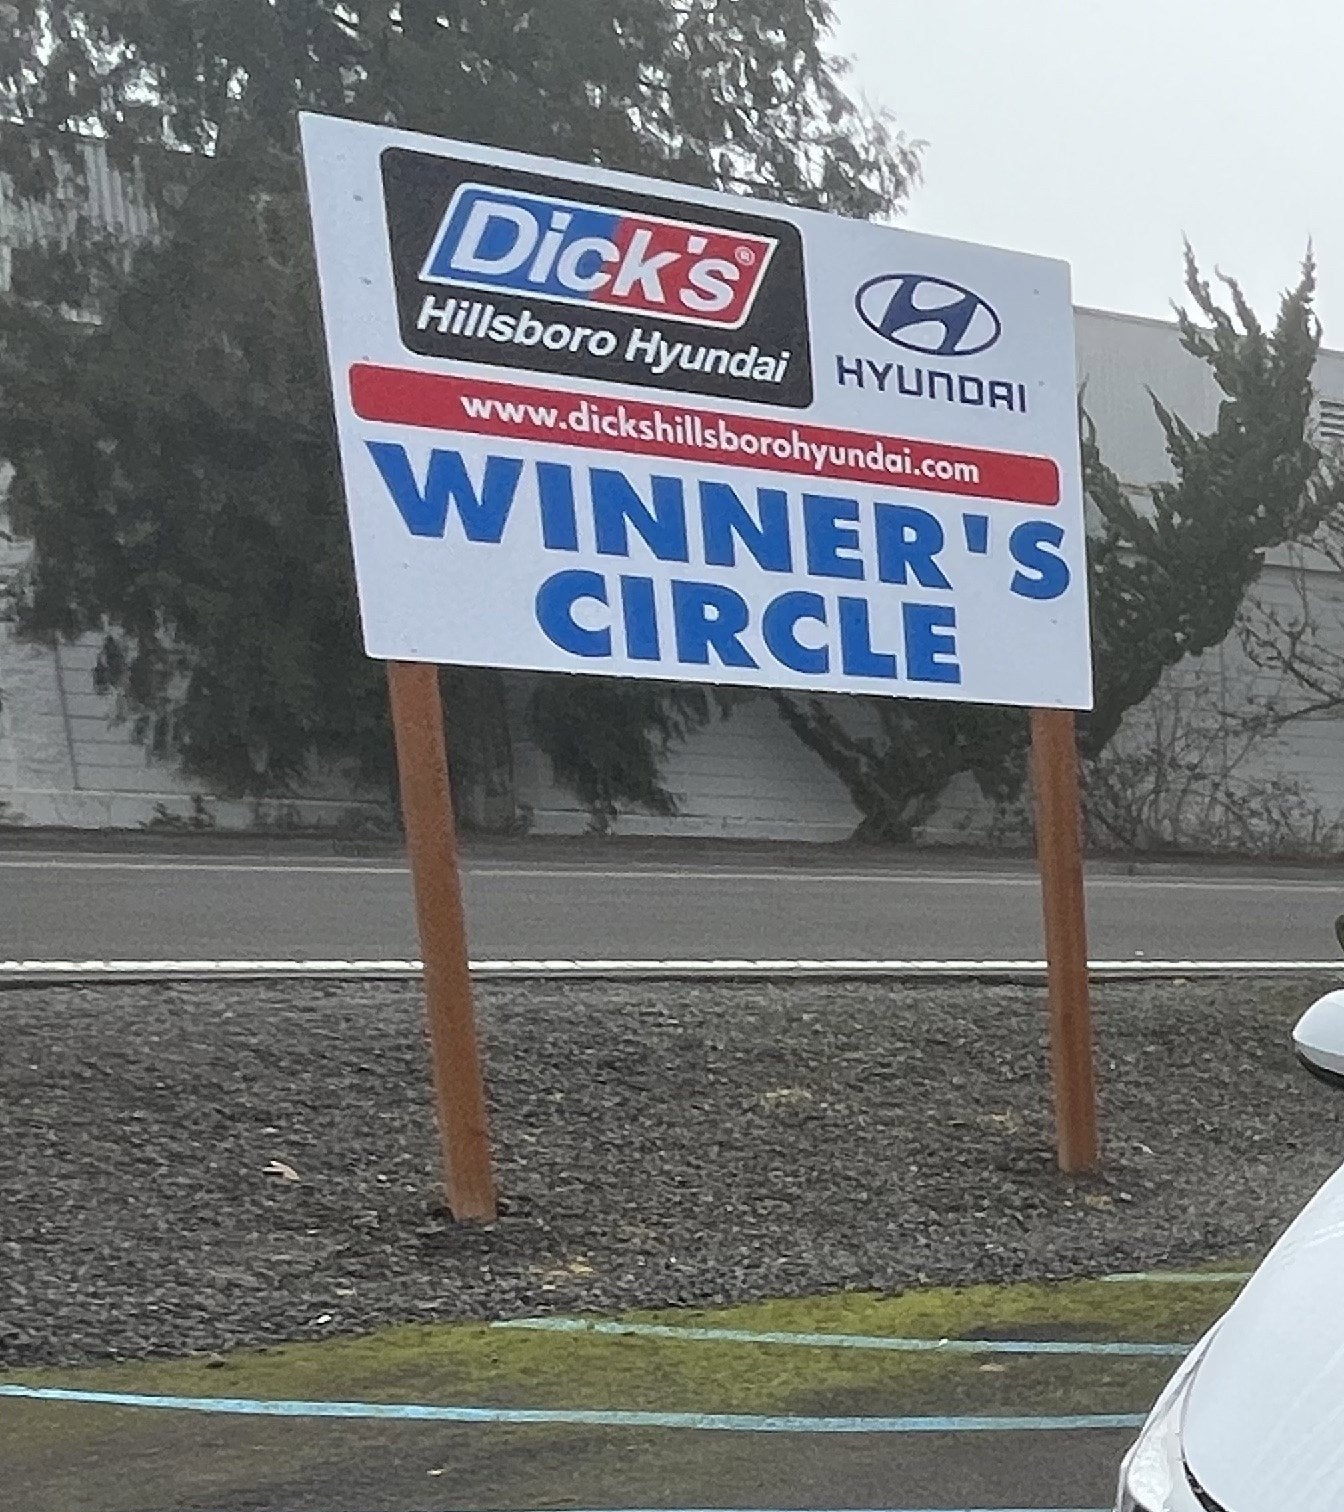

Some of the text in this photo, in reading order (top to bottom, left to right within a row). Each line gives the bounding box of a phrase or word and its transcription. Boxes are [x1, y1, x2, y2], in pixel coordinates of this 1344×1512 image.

[415, 296, 791, 384] Hillsboro Hyundai
[836, 354, 1027, 413] HYUNDAI
[461, 395, 980, 485] www.dickshillsborohyundai.com
[365, 440, 1070, 600] WINNER'S
[534, 567, 962, 684] CIRCLE
